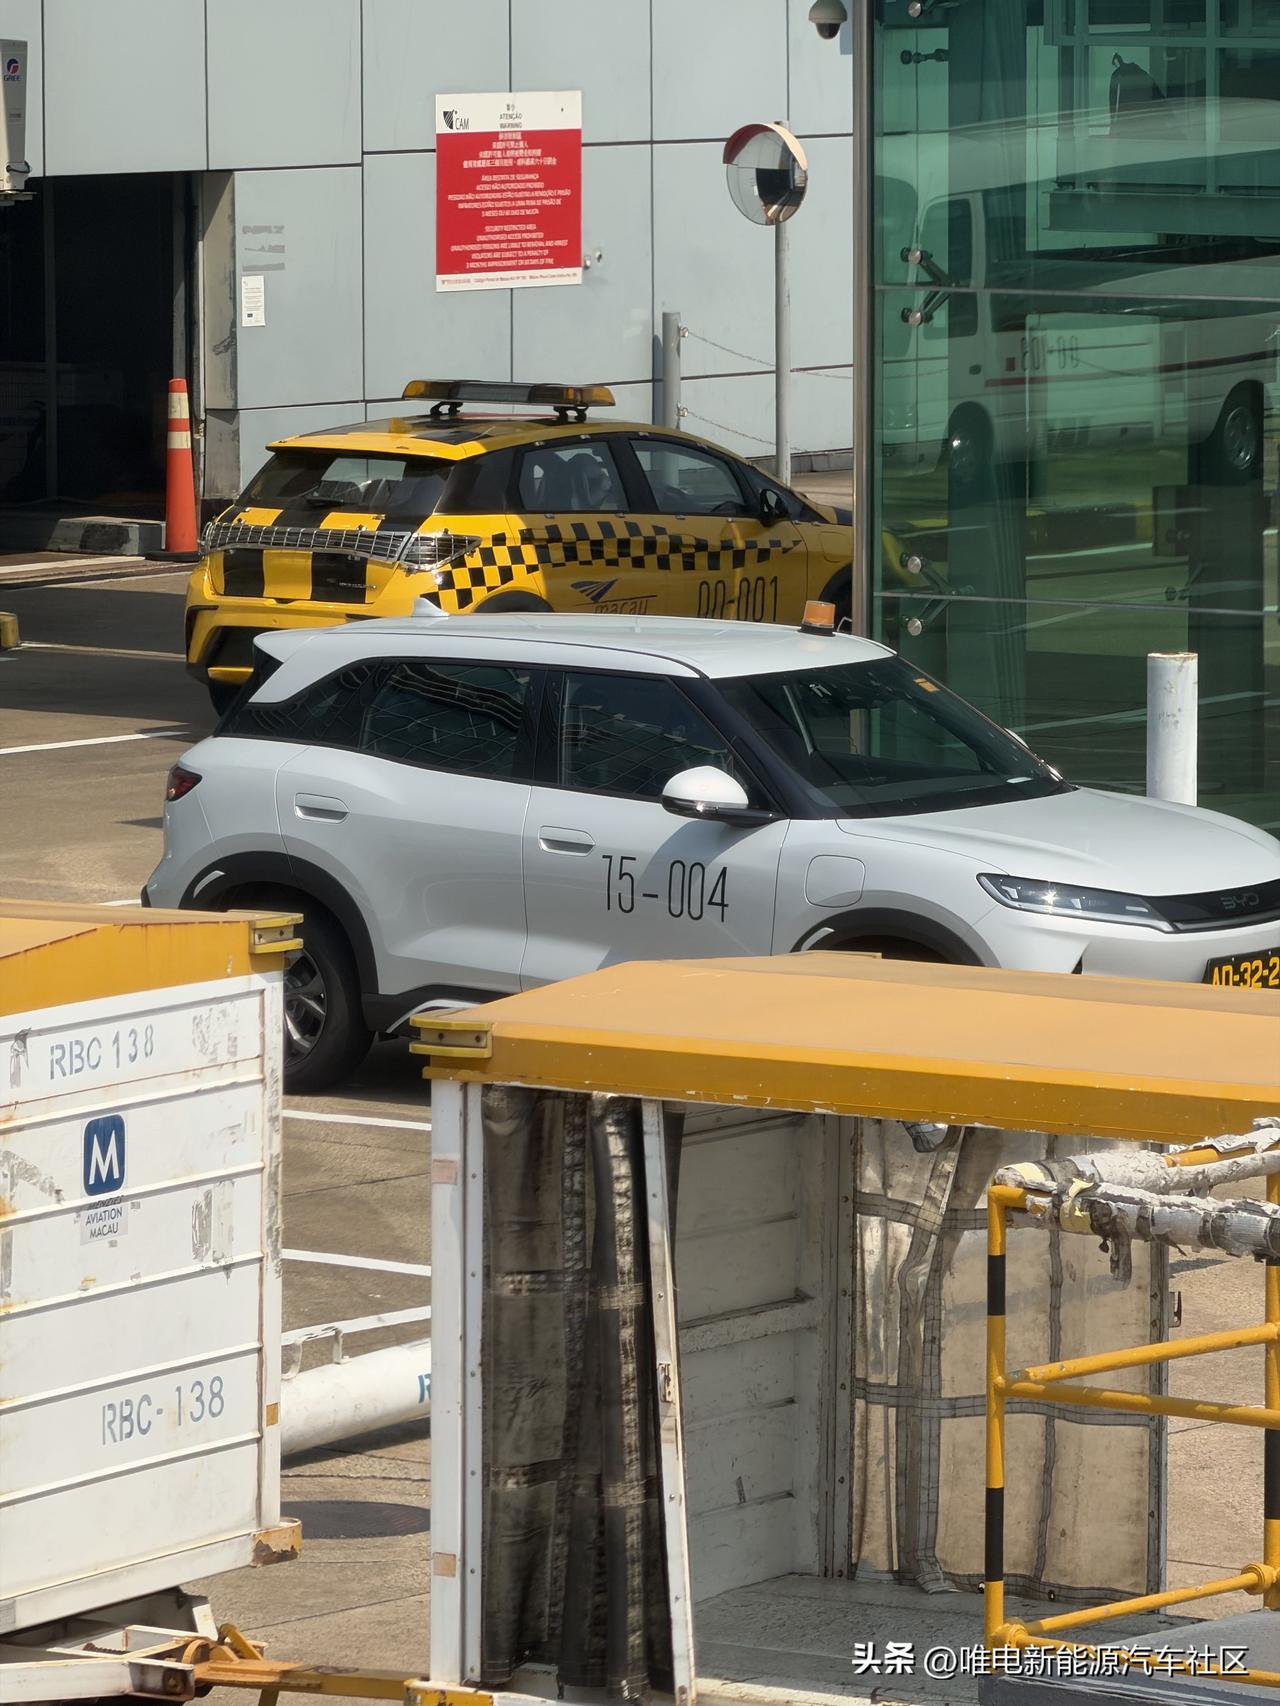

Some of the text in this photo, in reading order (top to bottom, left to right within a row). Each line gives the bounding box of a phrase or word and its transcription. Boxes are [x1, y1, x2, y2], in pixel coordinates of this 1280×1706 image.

[455, 118, 470, 130] CAM
[697, 576, 778, 622] 00-001
[602, 854, 729, 923] 15-004
[1220, 892, 1260, 910] BYD
[50, 1023, 154, 1080] RBC 138
[88, 1129, 120, 1185] M
[85, 1206, 123, 1226] AVIATION
[89, 1222, 119, 1240] MACAU
